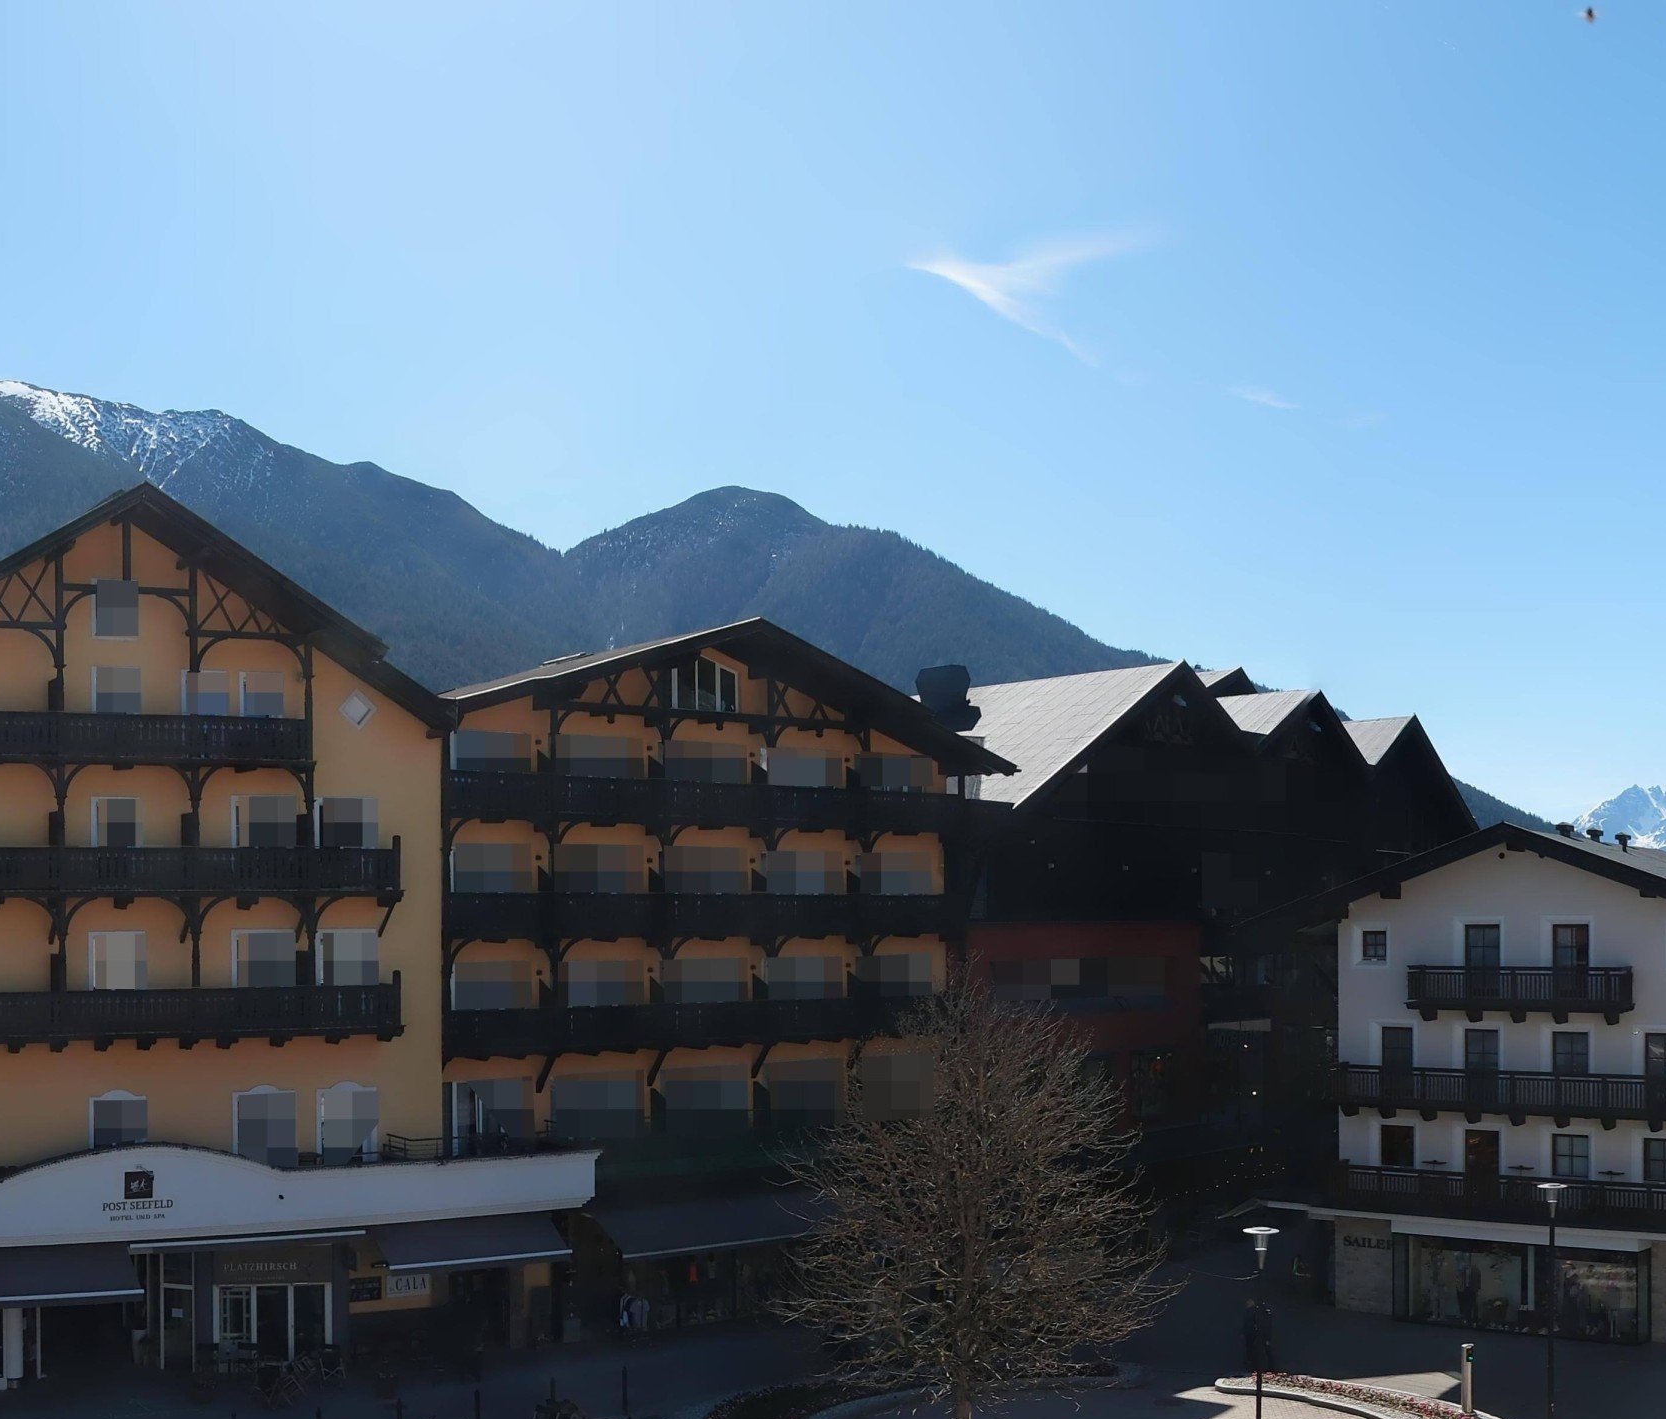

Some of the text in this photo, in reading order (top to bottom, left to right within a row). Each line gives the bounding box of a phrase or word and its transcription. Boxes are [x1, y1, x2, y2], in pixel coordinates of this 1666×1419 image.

[102, 1200, 174, 1211] POST SEEFELD
[223, 1262, 297, 1271] PLATZHIRSCH
[396, 1276, 426, 1291] CALA
